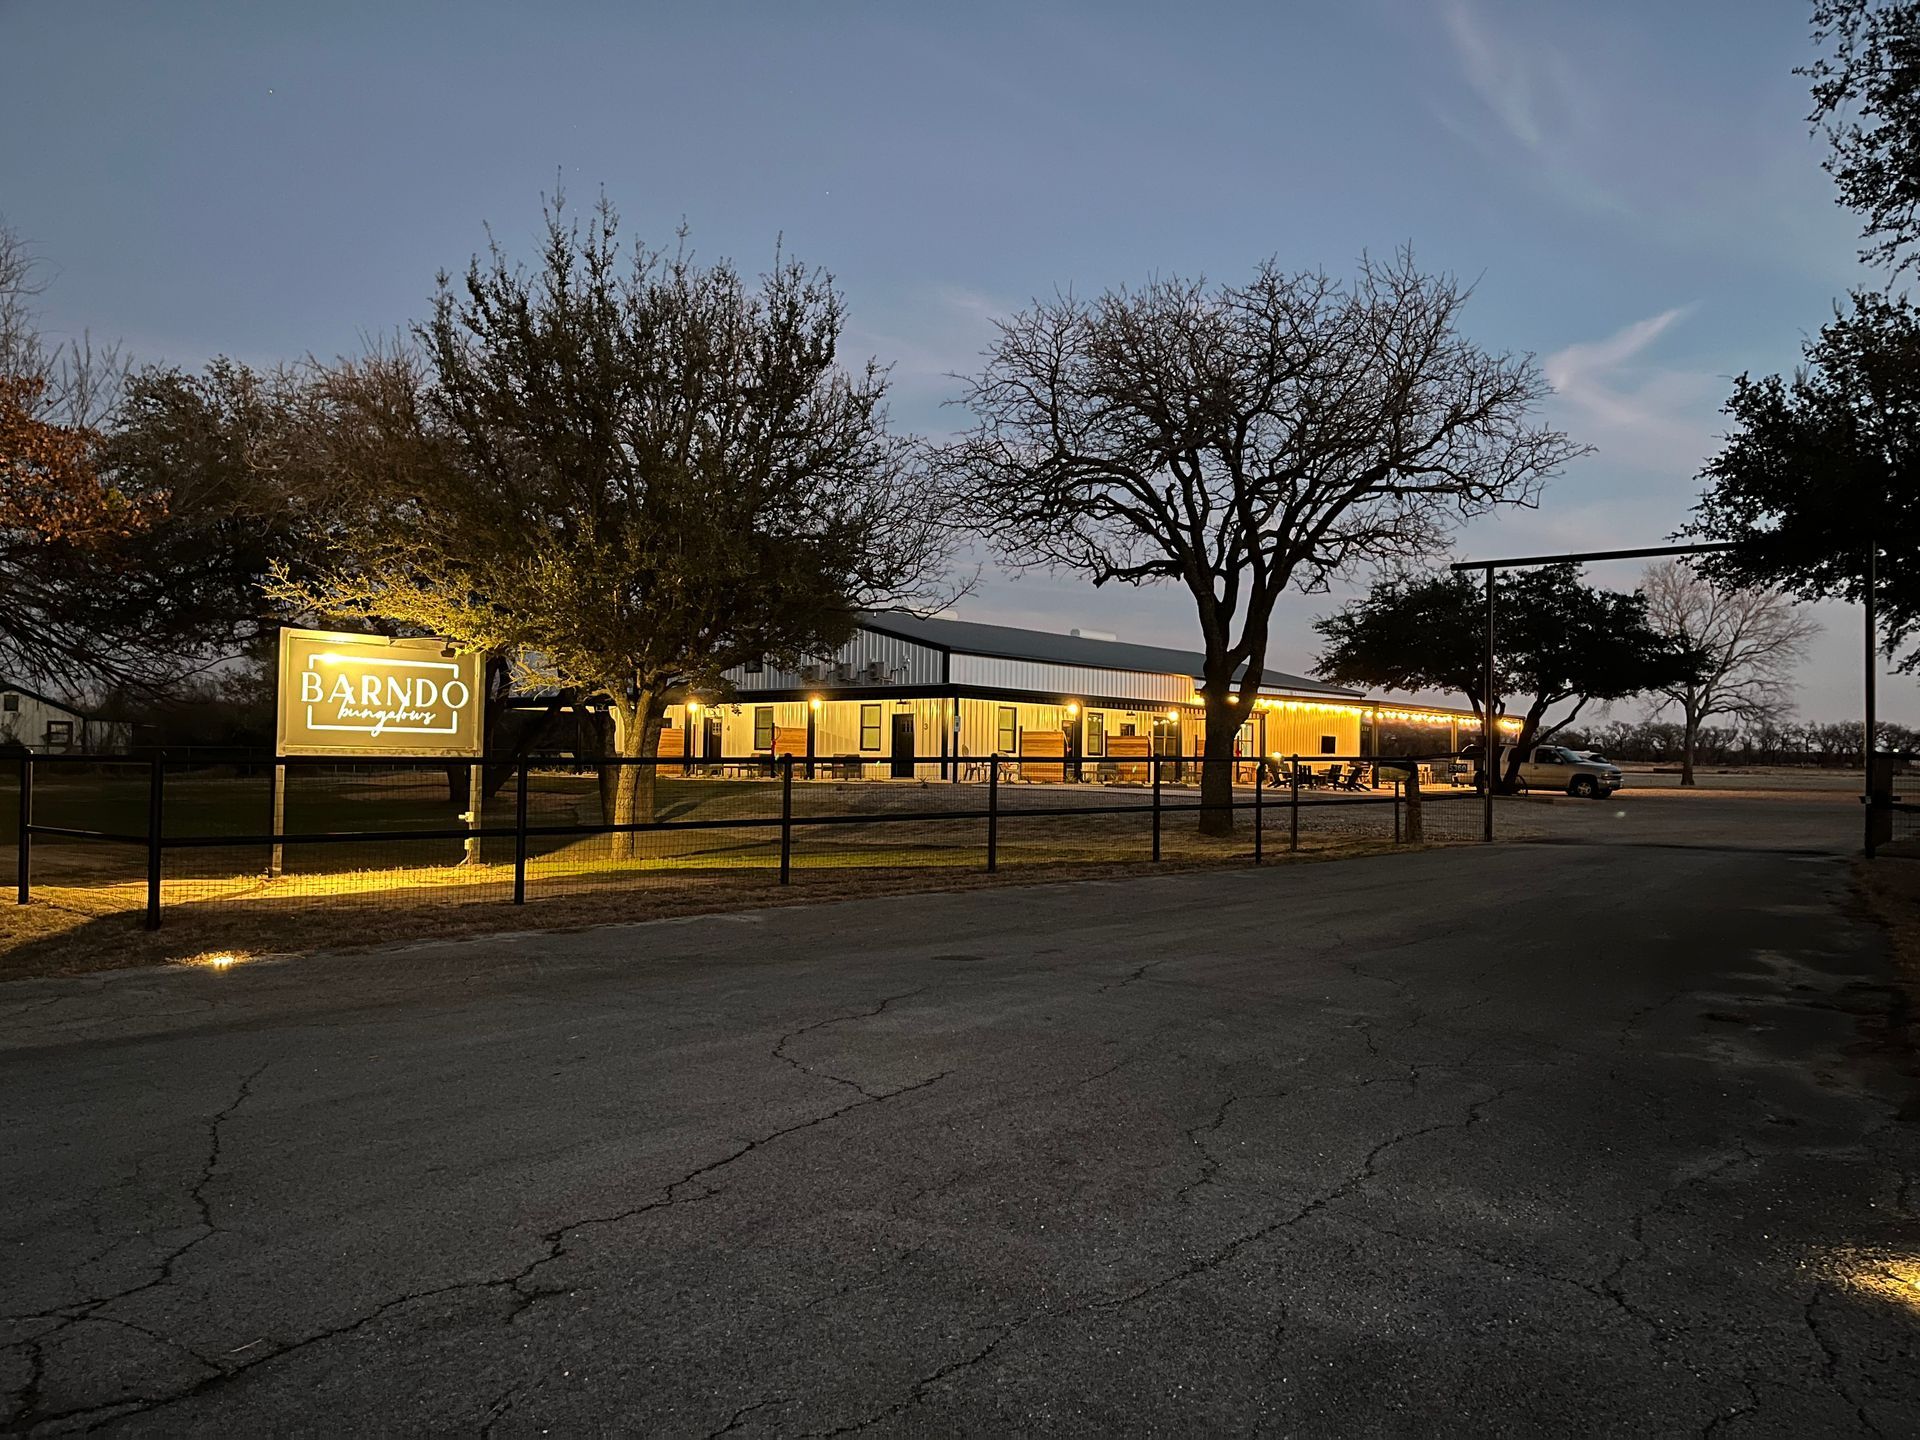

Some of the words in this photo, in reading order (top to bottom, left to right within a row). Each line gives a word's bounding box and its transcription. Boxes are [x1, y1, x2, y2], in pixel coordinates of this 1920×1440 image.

[301, 671, 470, 709] BARNDO
[337, 686, 436, 737] bungalows
[923, 722, 929, 731] 3
[1449, 764, 1467, 772] 5360
